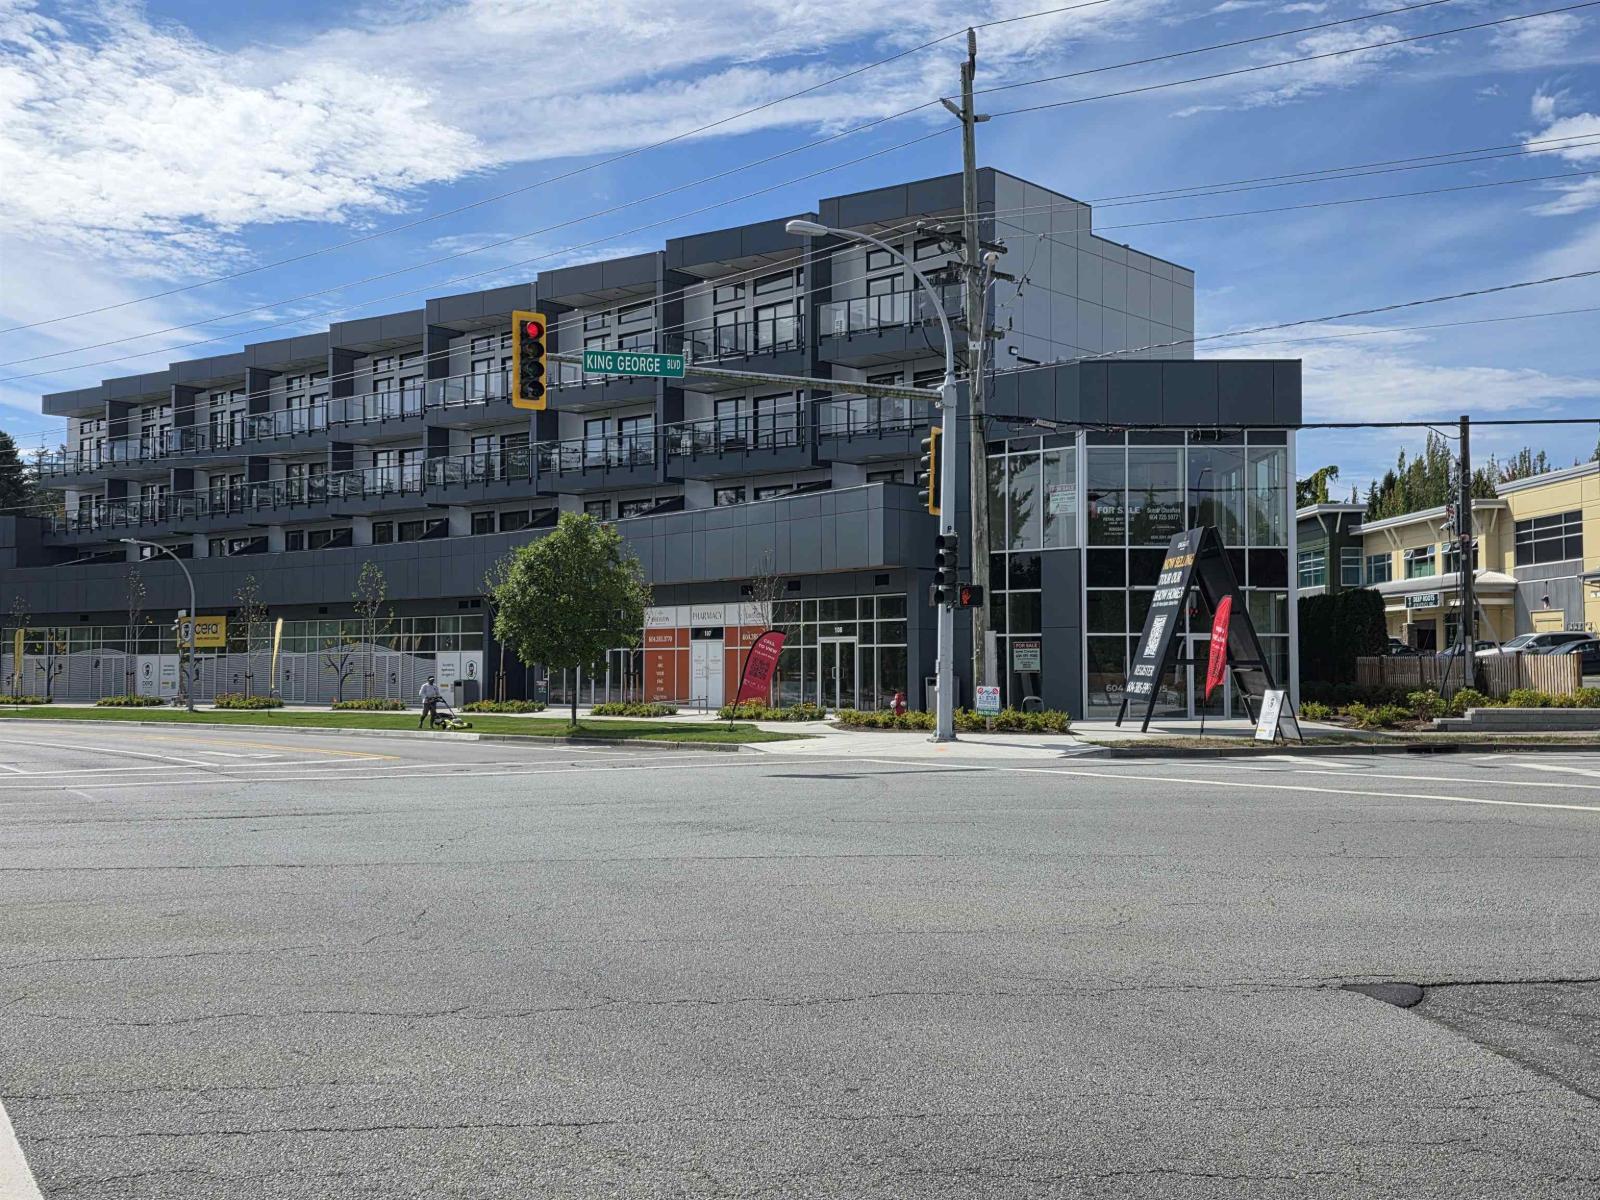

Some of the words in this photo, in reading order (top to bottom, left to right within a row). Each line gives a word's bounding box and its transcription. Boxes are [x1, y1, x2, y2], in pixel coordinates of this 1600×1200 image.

[586, 354, 613, 370] KING
[617, 356, 661, 373] GEORGE
[666, 359, 681, 370] BLVD
[1096, 506, 1115, 514] FOR
[1117, 506, 1140, 514] SLE
[1162, 557, 1177, 570] NOW
[1170, 571, 1182, 584] OUR
[692, 610, 722, 621] PHARMACY
[194, 623, 218, 635] cefa
[763, 638, 775, 647] CALL
[765, 645, 778, 654] VIEW
[1105, 684, 1124, 692] 604
